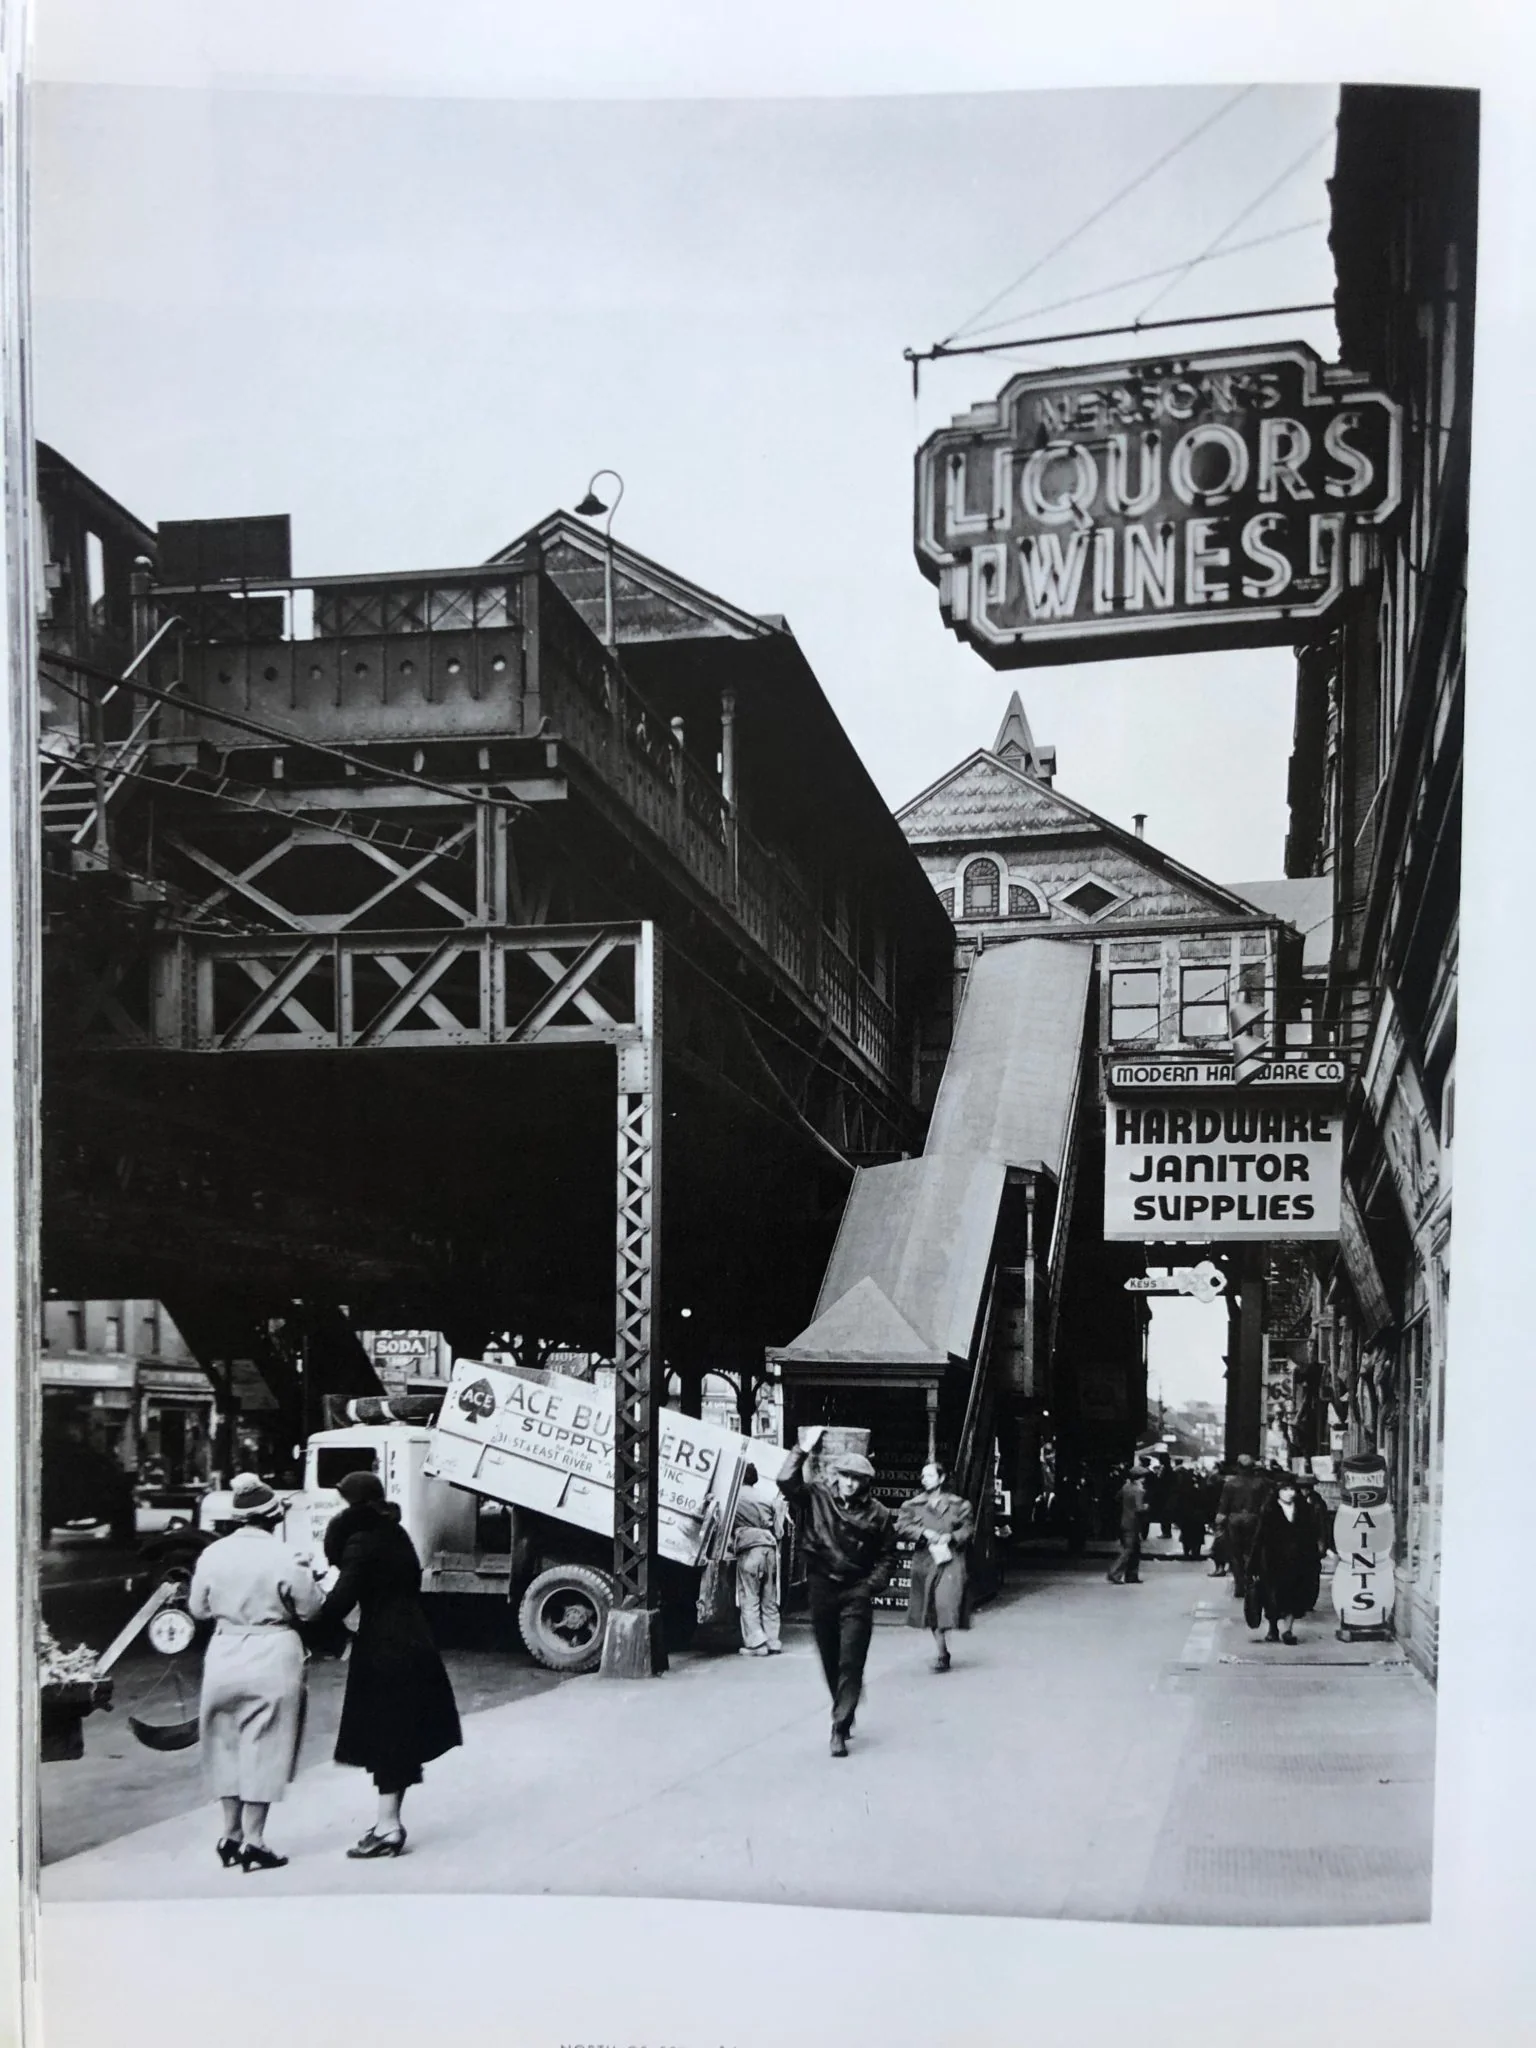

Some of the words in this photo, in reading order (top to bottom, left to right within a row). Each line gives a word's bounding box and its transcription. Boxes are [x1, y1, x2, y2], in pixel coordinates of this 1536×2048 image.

[946, 411, 1374, 537] LIQUORS
[1016, 512, 1293, 620] WINES
[1116, 1066, 1198, 1083] MODERN
[1206, 1065, 1308, 1082] HAWARE
[1315, 1064, 1342, 1080] CO.
[1115, 1108, 1332, 1145] HARDWARE
[1129, 1153, 1310, 1183] JANITOR
[1133, 1194, 1315, 1221] SUPPLIES
[1130, 1279, 1157, 1288] KEYS
[376, 1340, 425, 1353] SODA
[462, 1389, 493, 1409] ACE
[505, 1383, 562, 1420] ACE
[572, 1404, 715, 1473] BUERS
[521, 1417, 615, 1458] SUPPLY
[532, 1445, 559, 1461] EAST
[562, 1455, 593, 1473] RIVER
[1350, 1491, 1378, 1611] PAINTS
